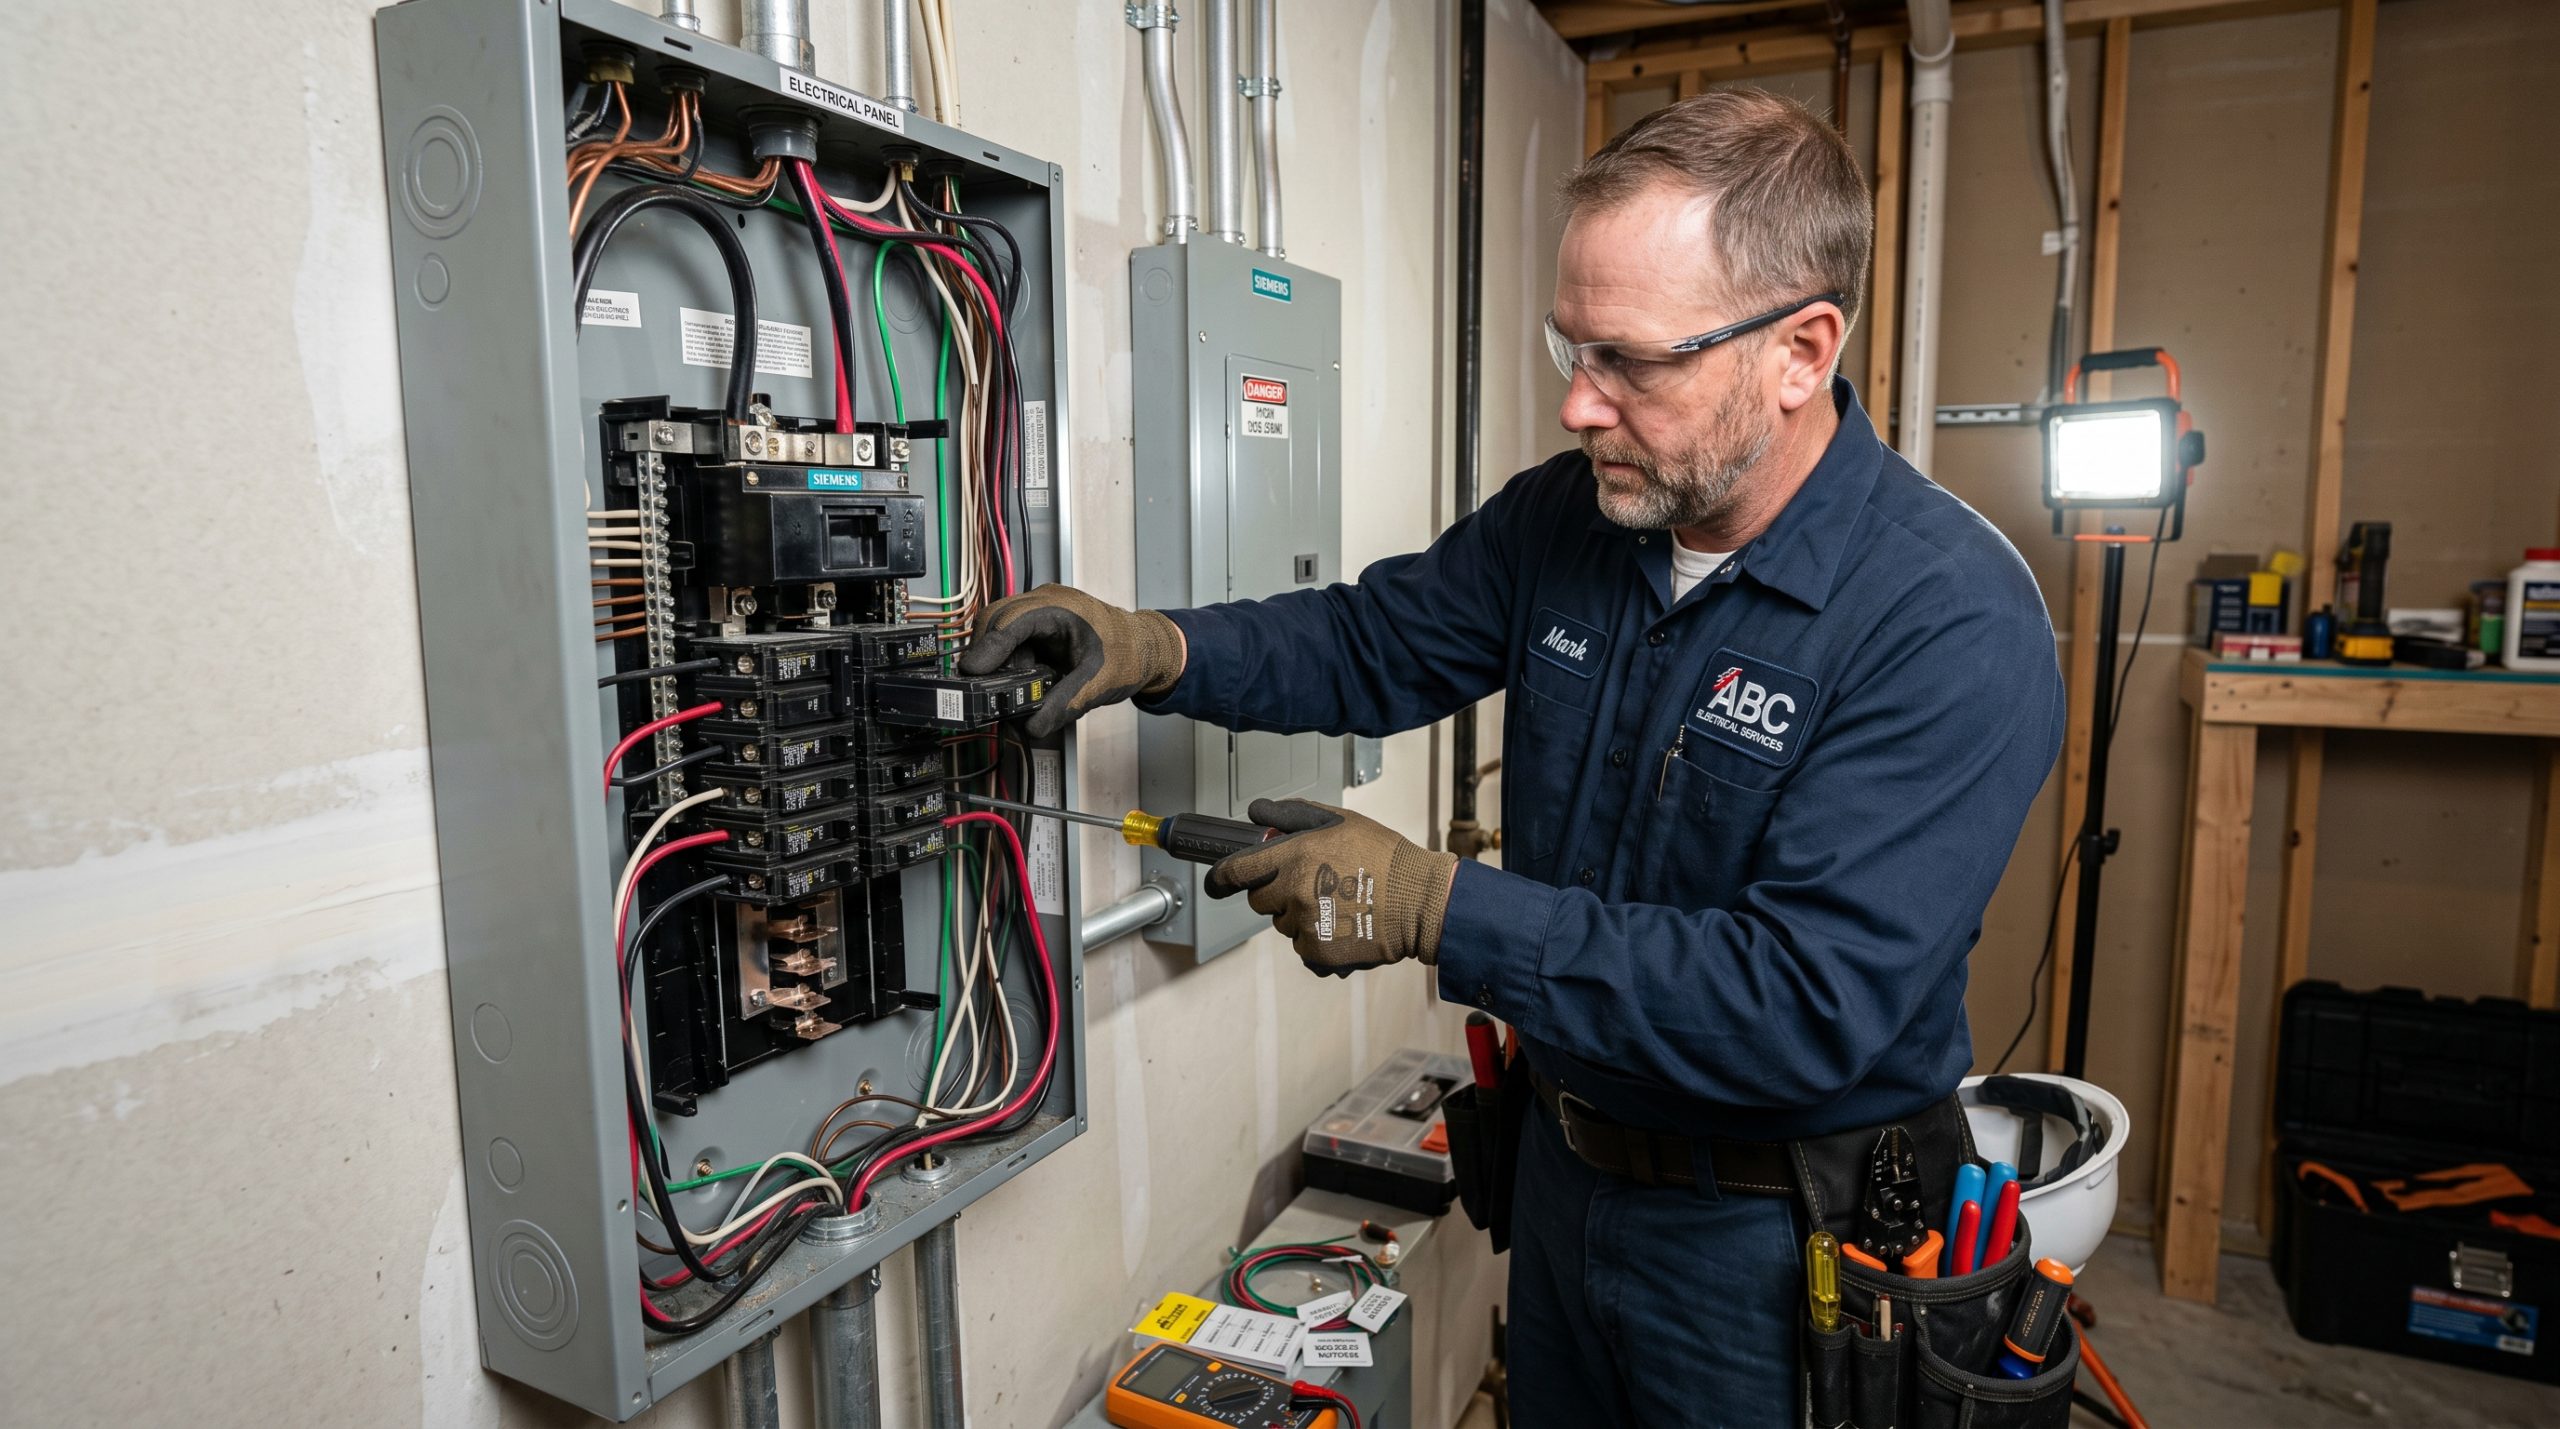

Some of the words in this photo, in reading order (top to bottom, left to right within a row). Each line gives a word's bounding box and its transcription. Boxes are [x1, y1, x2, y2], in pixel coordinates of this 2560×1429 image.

[788, 76, 862, 115] ELECTRICAL
[864, 104, 900, 129] PANEL
[1254, 274, 1289, 297] SIEMENS
[1246, 382, 1284, 400] DANGER
[813, 473, 858, 487] SIEMENS
[1541, 625, 1588, 661] Mark
[1707, 675, 1796, 735] ABC
[1740, 726, 1784, 752] SERVICES
